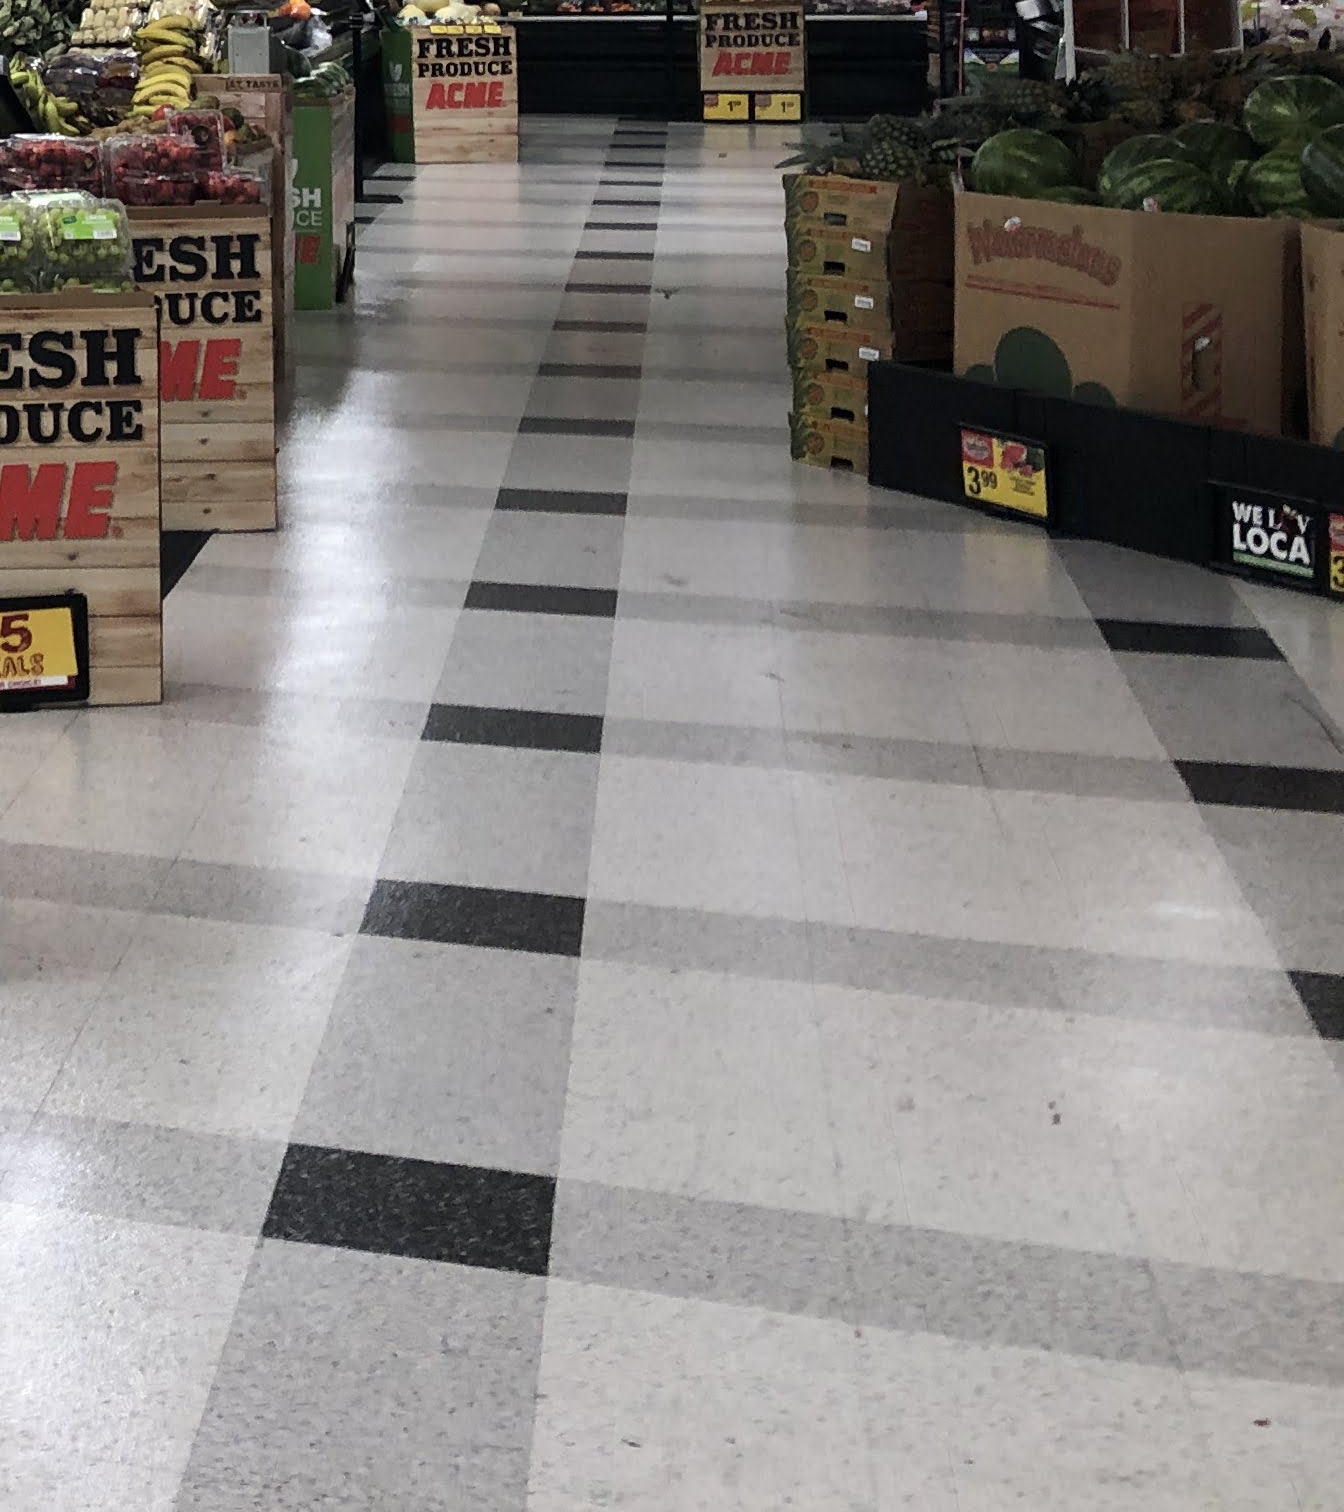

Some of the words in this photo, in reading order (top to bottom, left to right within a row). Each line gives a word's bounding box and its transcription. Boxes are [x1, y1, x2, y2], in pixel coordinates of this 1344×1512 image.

[705, 12, 800, 31] FRESH
[417, 36, 512, 58] FRESH
[705, 33, 800, 48] PRODUCE
[417, 61, 513, 78] PRODUCE
[712, 51, 791, 77] ACME
[426, 81, 504, 109] ACME
[132, 233, 261, 283] ESH
[1232, 501, 1263, 526] WE
